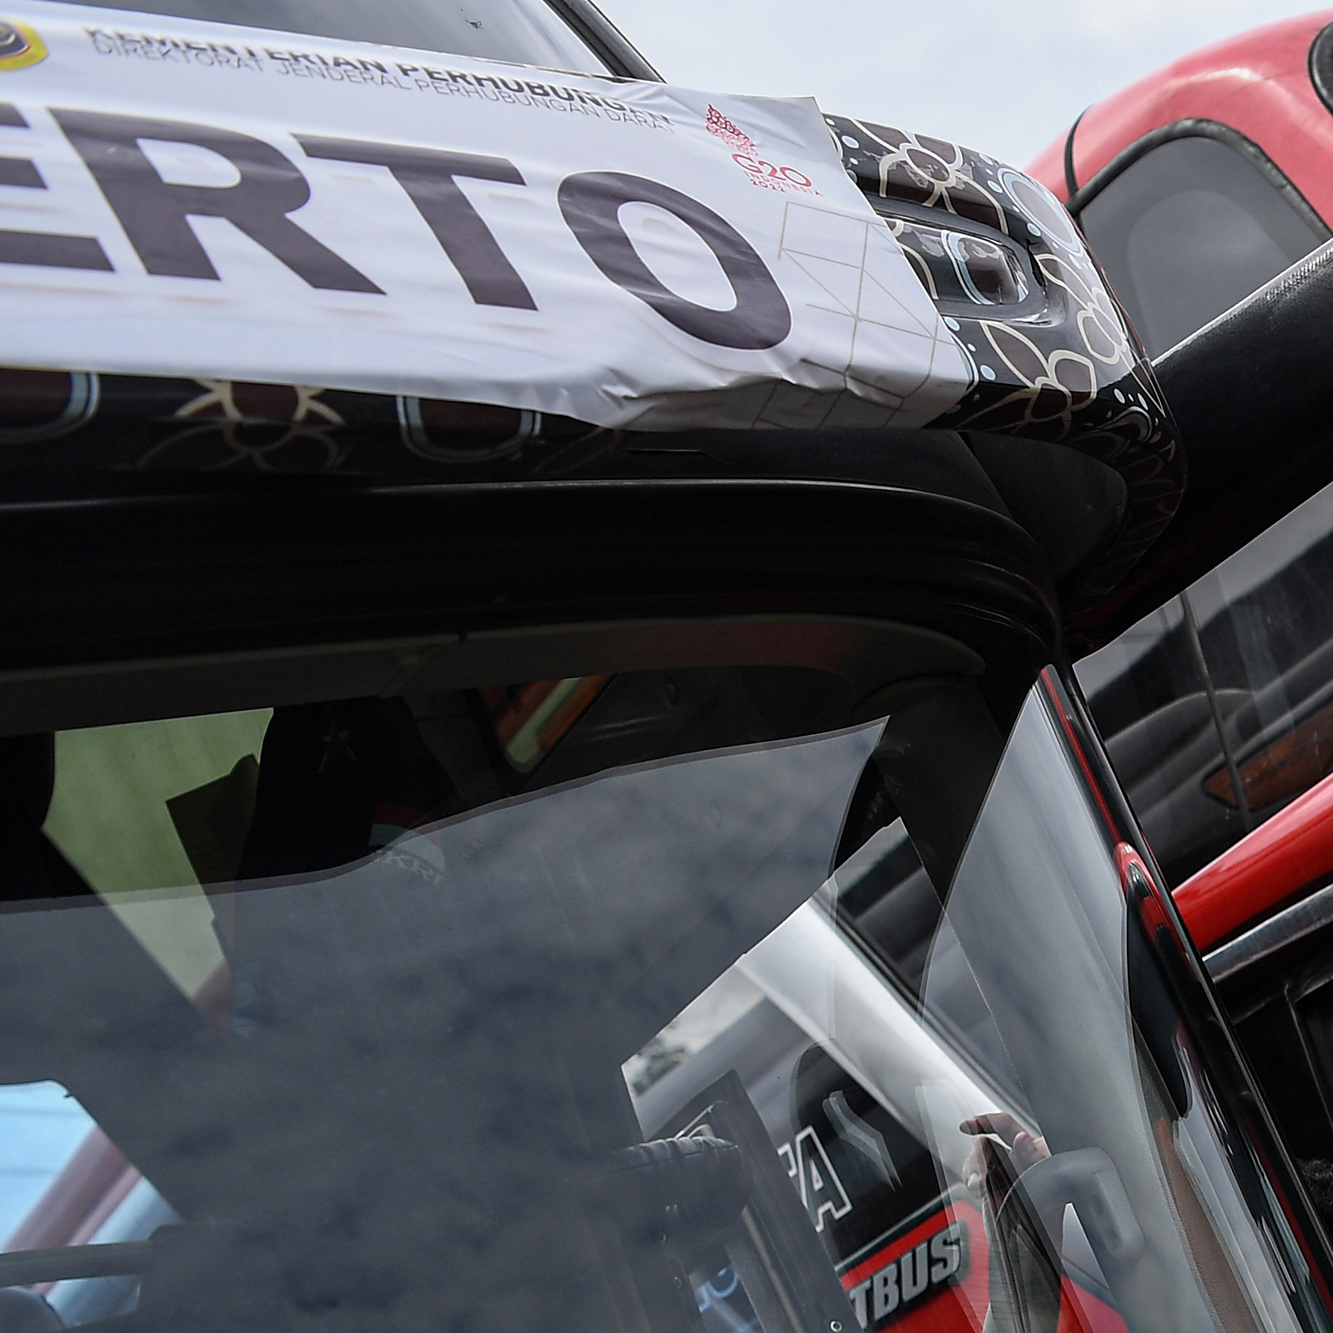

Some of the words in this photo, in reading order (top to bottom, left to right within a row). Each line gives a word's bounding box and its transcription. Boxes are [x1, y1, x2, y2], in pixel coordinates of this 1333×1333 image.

[278, 60, 411, 90] JENDERAL
[416, 79, 600, 118] PERHUBUNGAN
[605, 108, 675, 134] DARAT
[732, 153, 812, 187] G20
